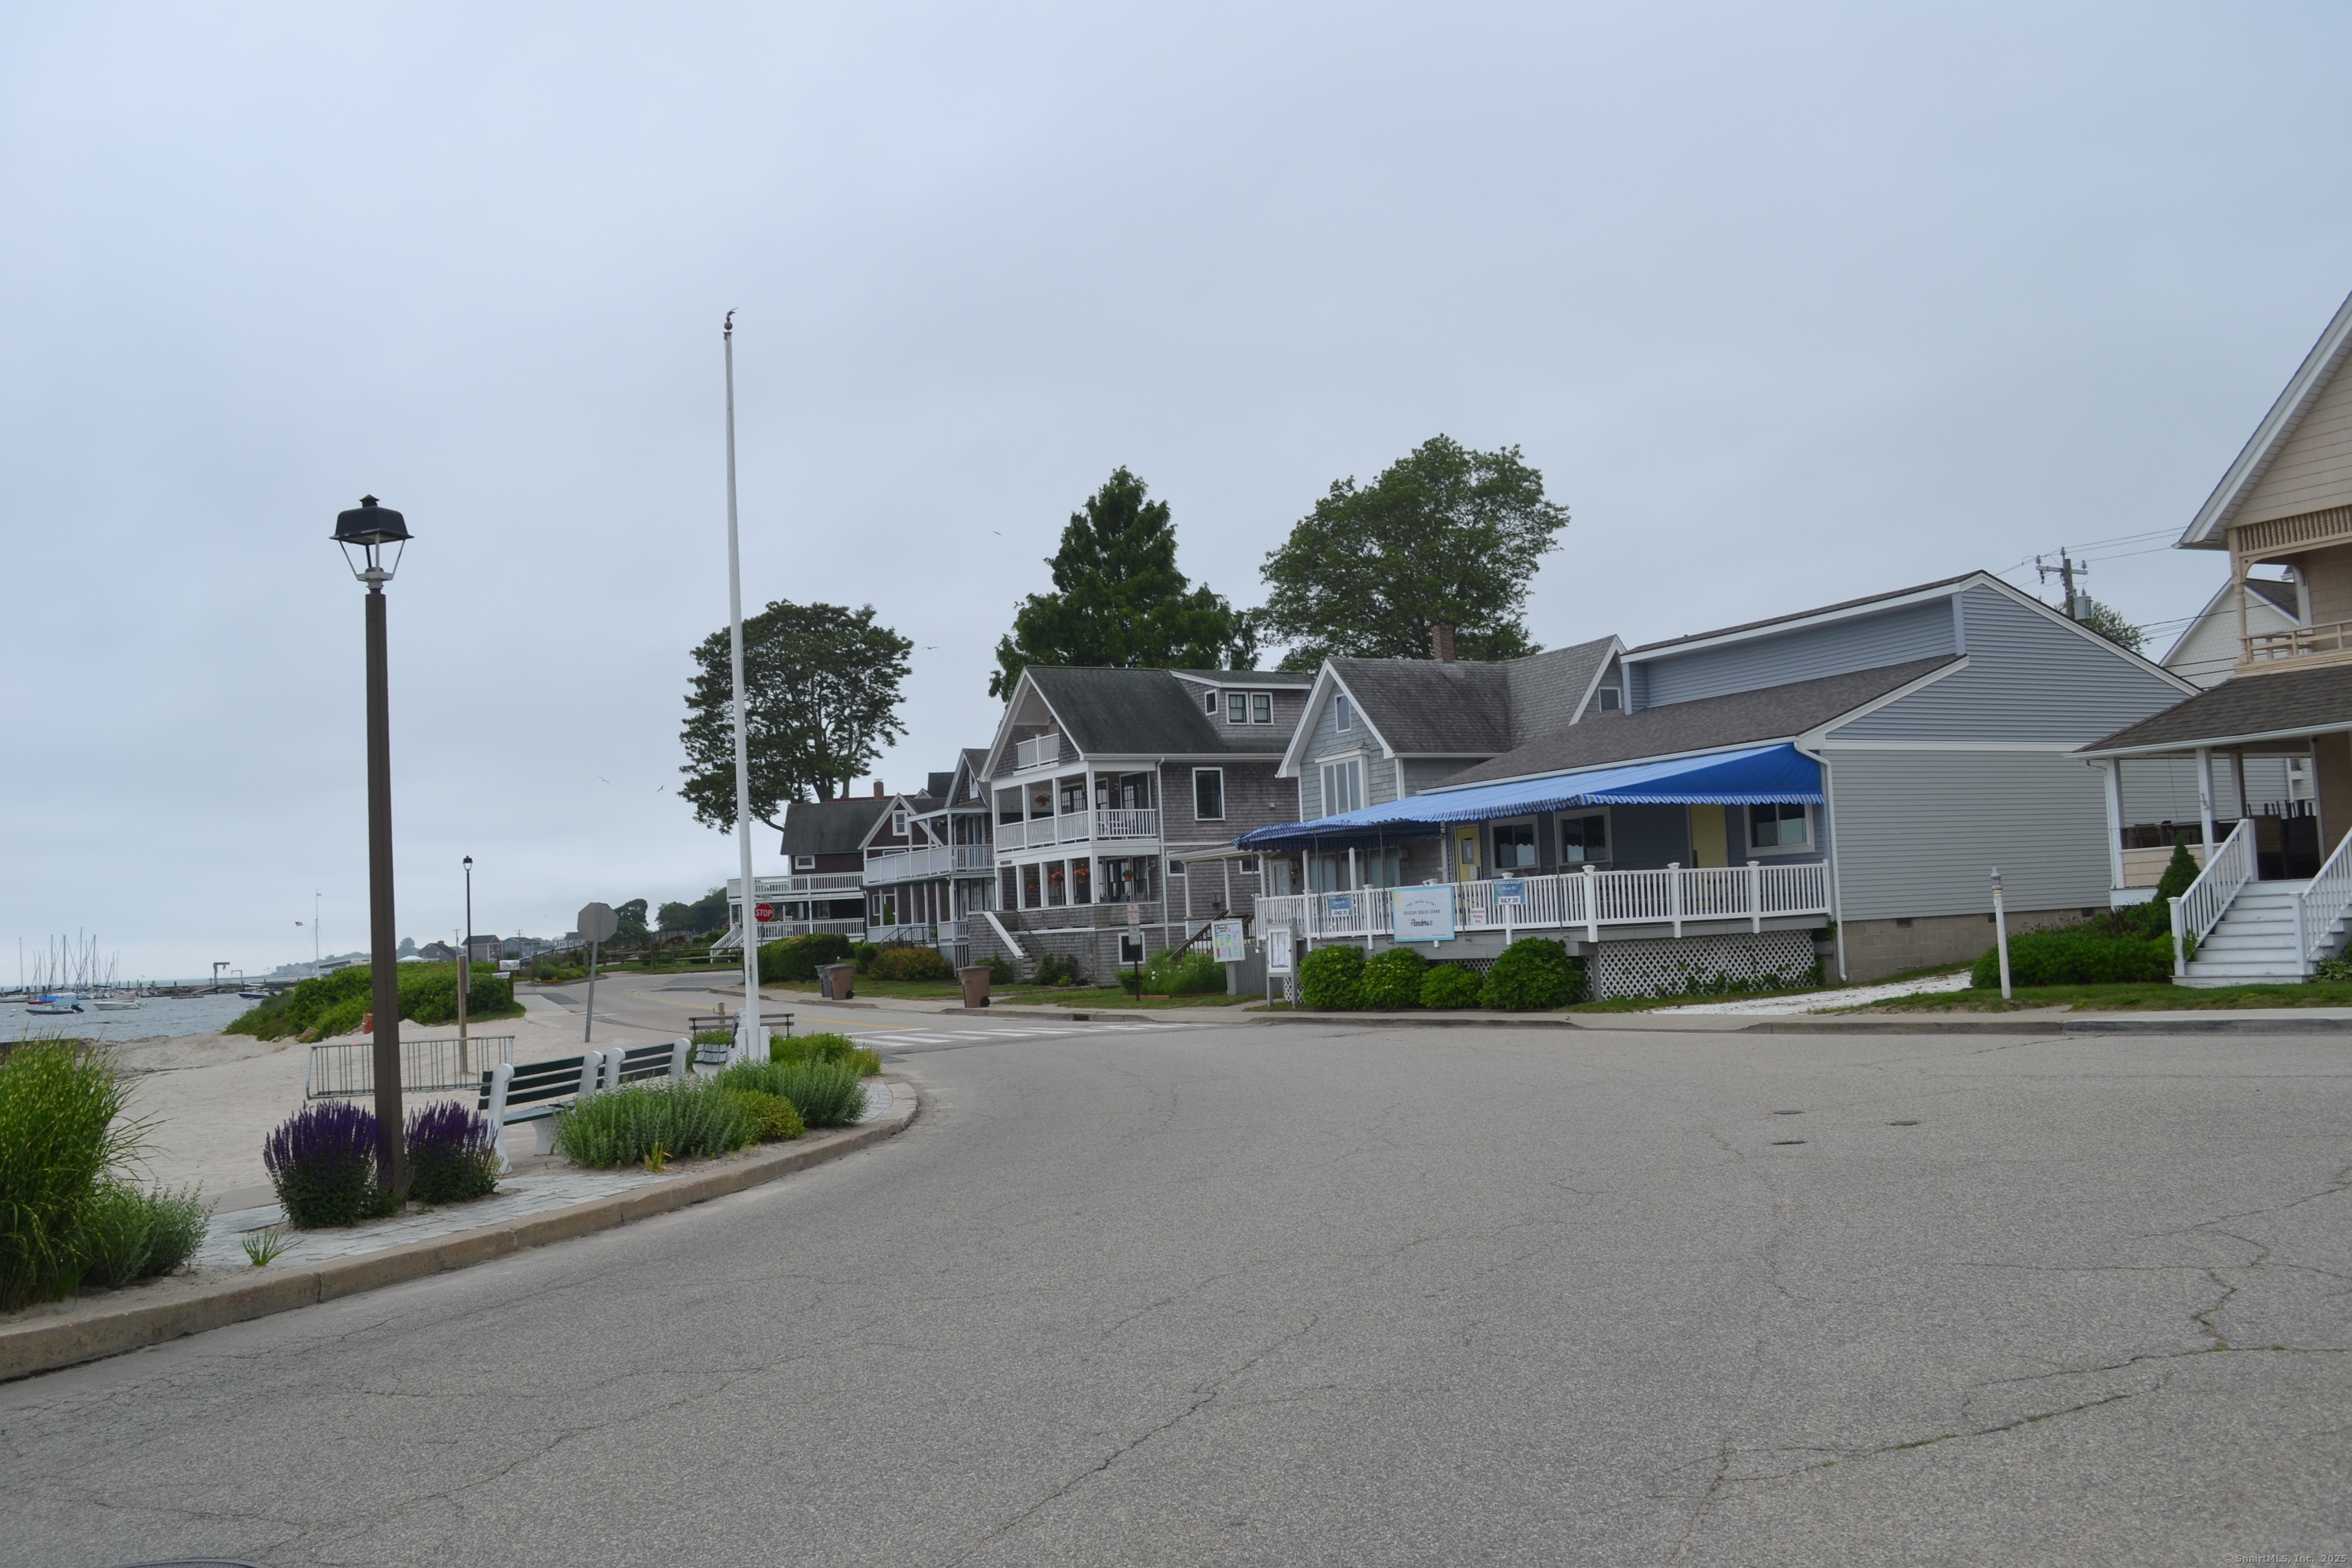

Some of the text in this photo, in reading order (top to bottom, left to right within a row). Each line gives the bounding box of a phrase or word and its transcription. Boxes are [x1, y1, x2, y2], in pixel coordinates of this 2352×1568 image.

[2199, 792, 2210, 811] 35
[755, 908, 773, 917] STOP
[1410, 918, 1429, 926] Flanders
